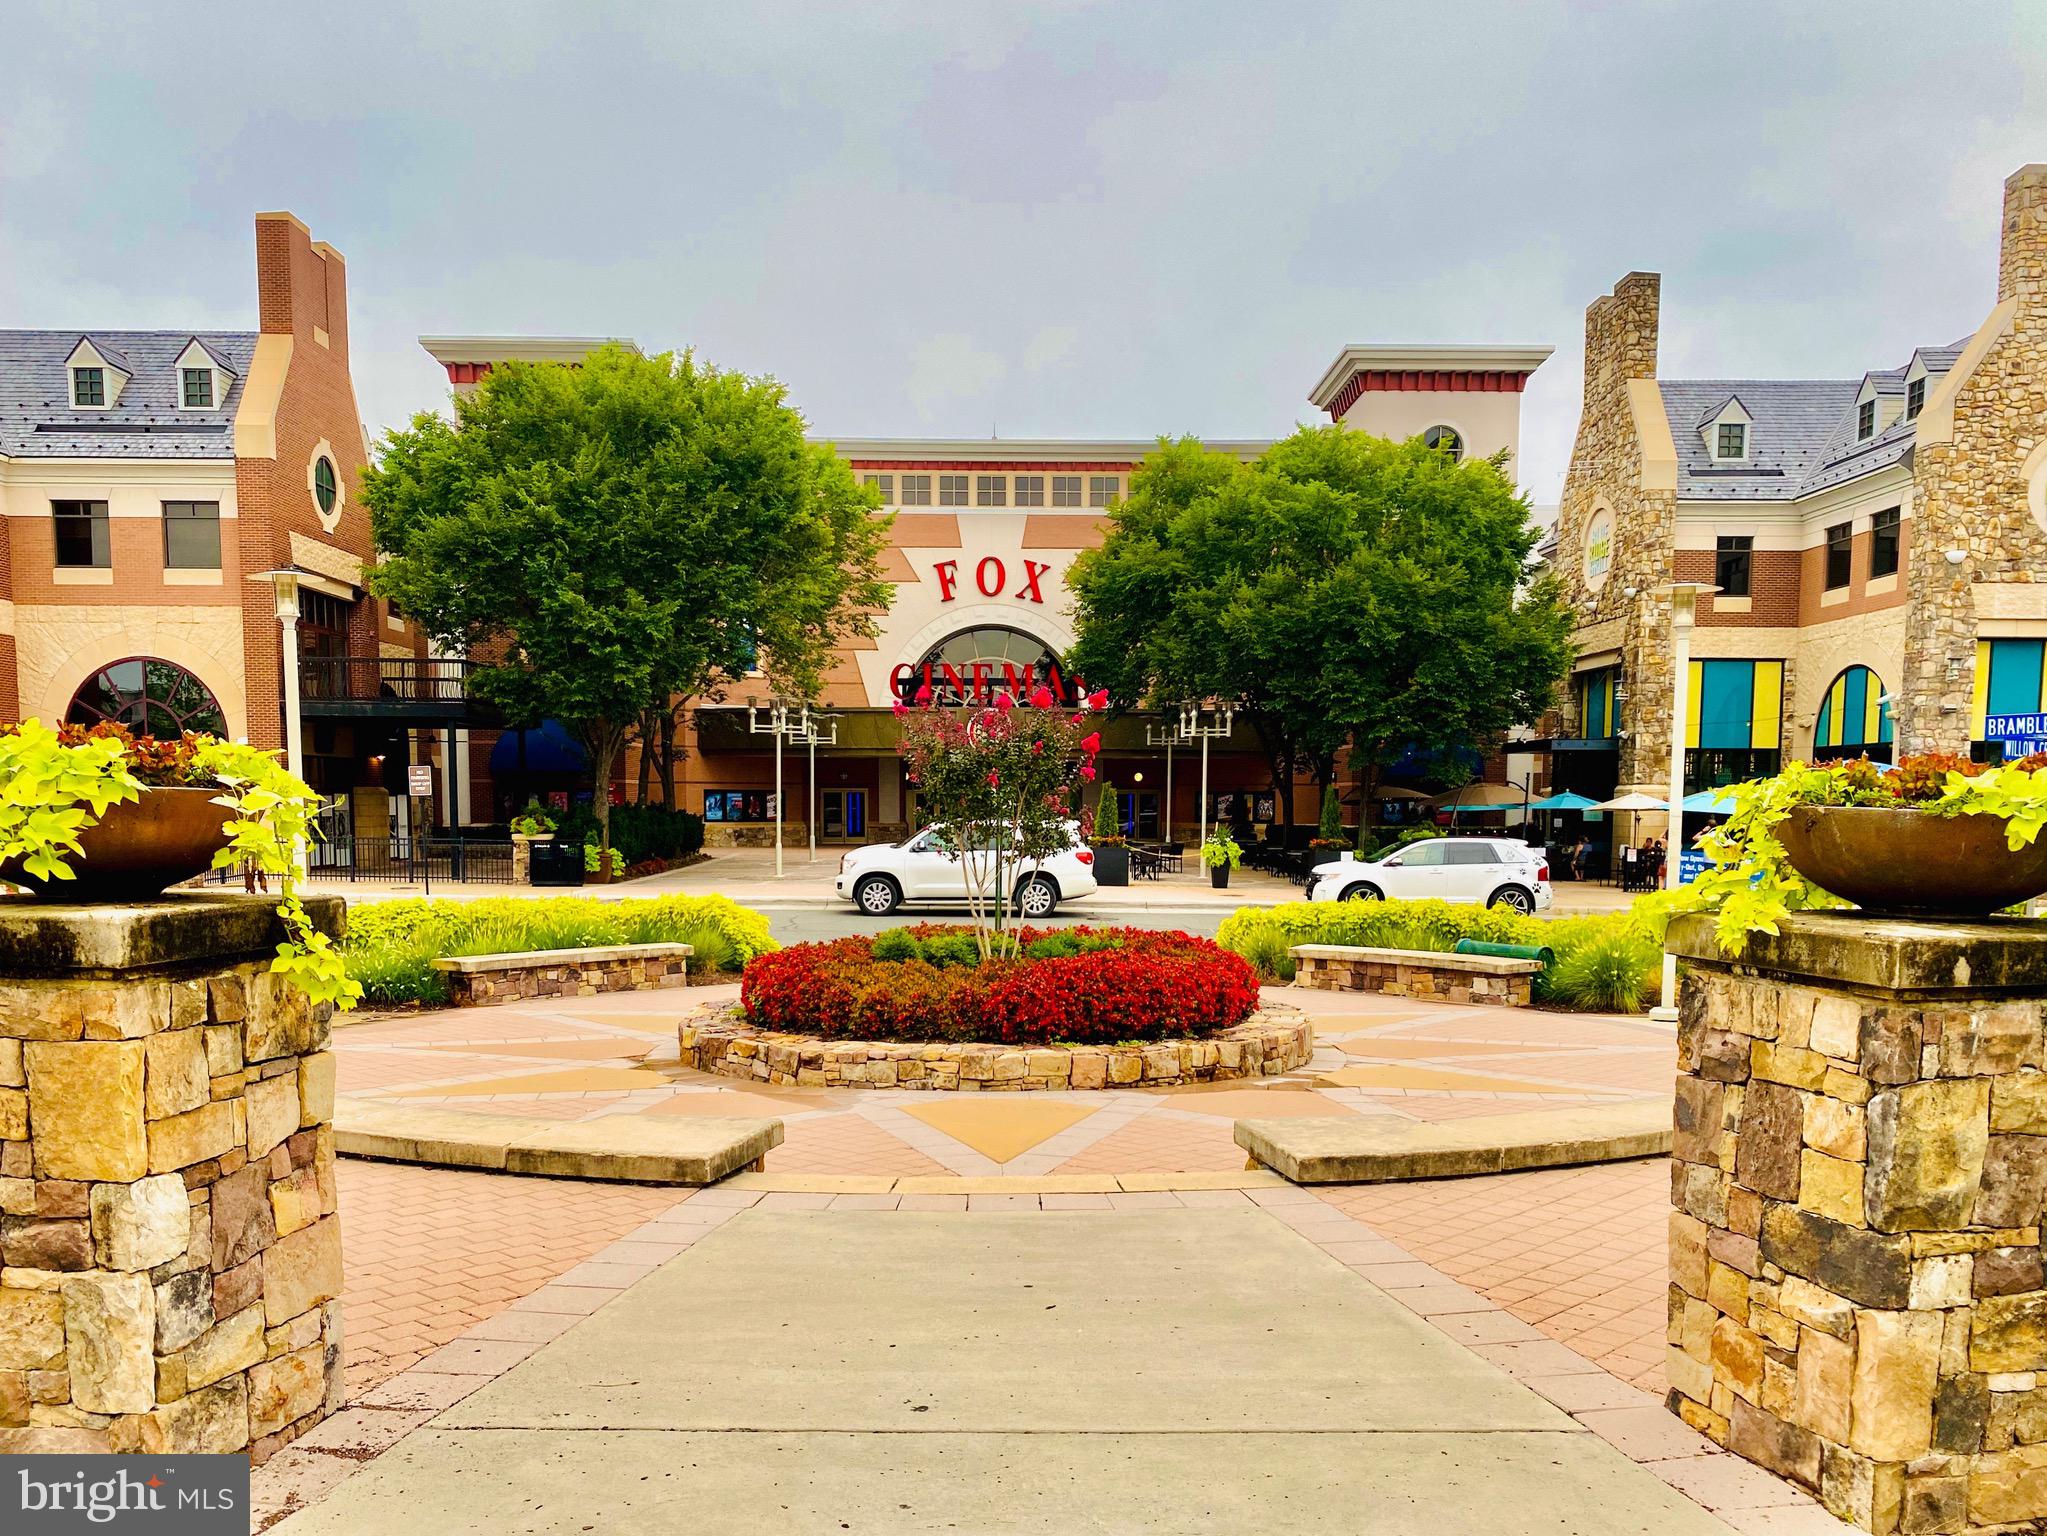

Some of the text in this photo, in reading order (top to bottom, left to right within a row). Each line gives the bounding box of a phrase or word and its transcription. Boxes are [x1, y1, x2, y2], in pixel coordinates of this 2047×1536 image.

[933, 556, 1051, 604] FOX
[889, 662, 1089, 702] CINEMAS
[2005, 739, 2035, 757] WILLOW
